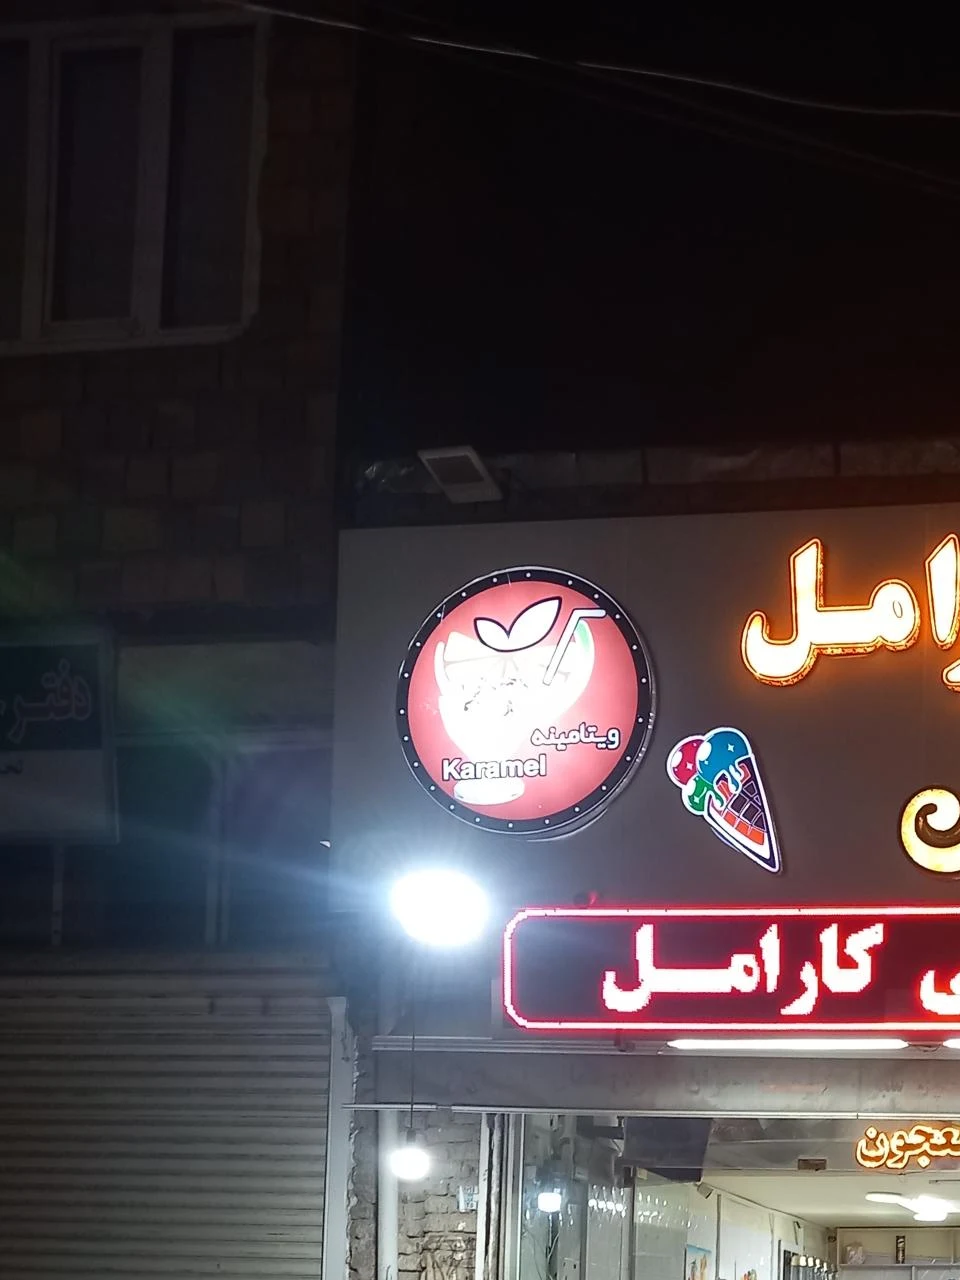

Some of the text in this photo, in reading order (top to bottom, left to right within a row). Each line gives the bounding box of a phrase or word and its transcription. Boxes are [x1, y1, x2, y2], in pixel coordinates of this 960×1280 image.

[529, 721, 621, 751] ویتامینه
[441, 753, 548, 782] Karamel
[602, 921, 885, 1016] کارامل
